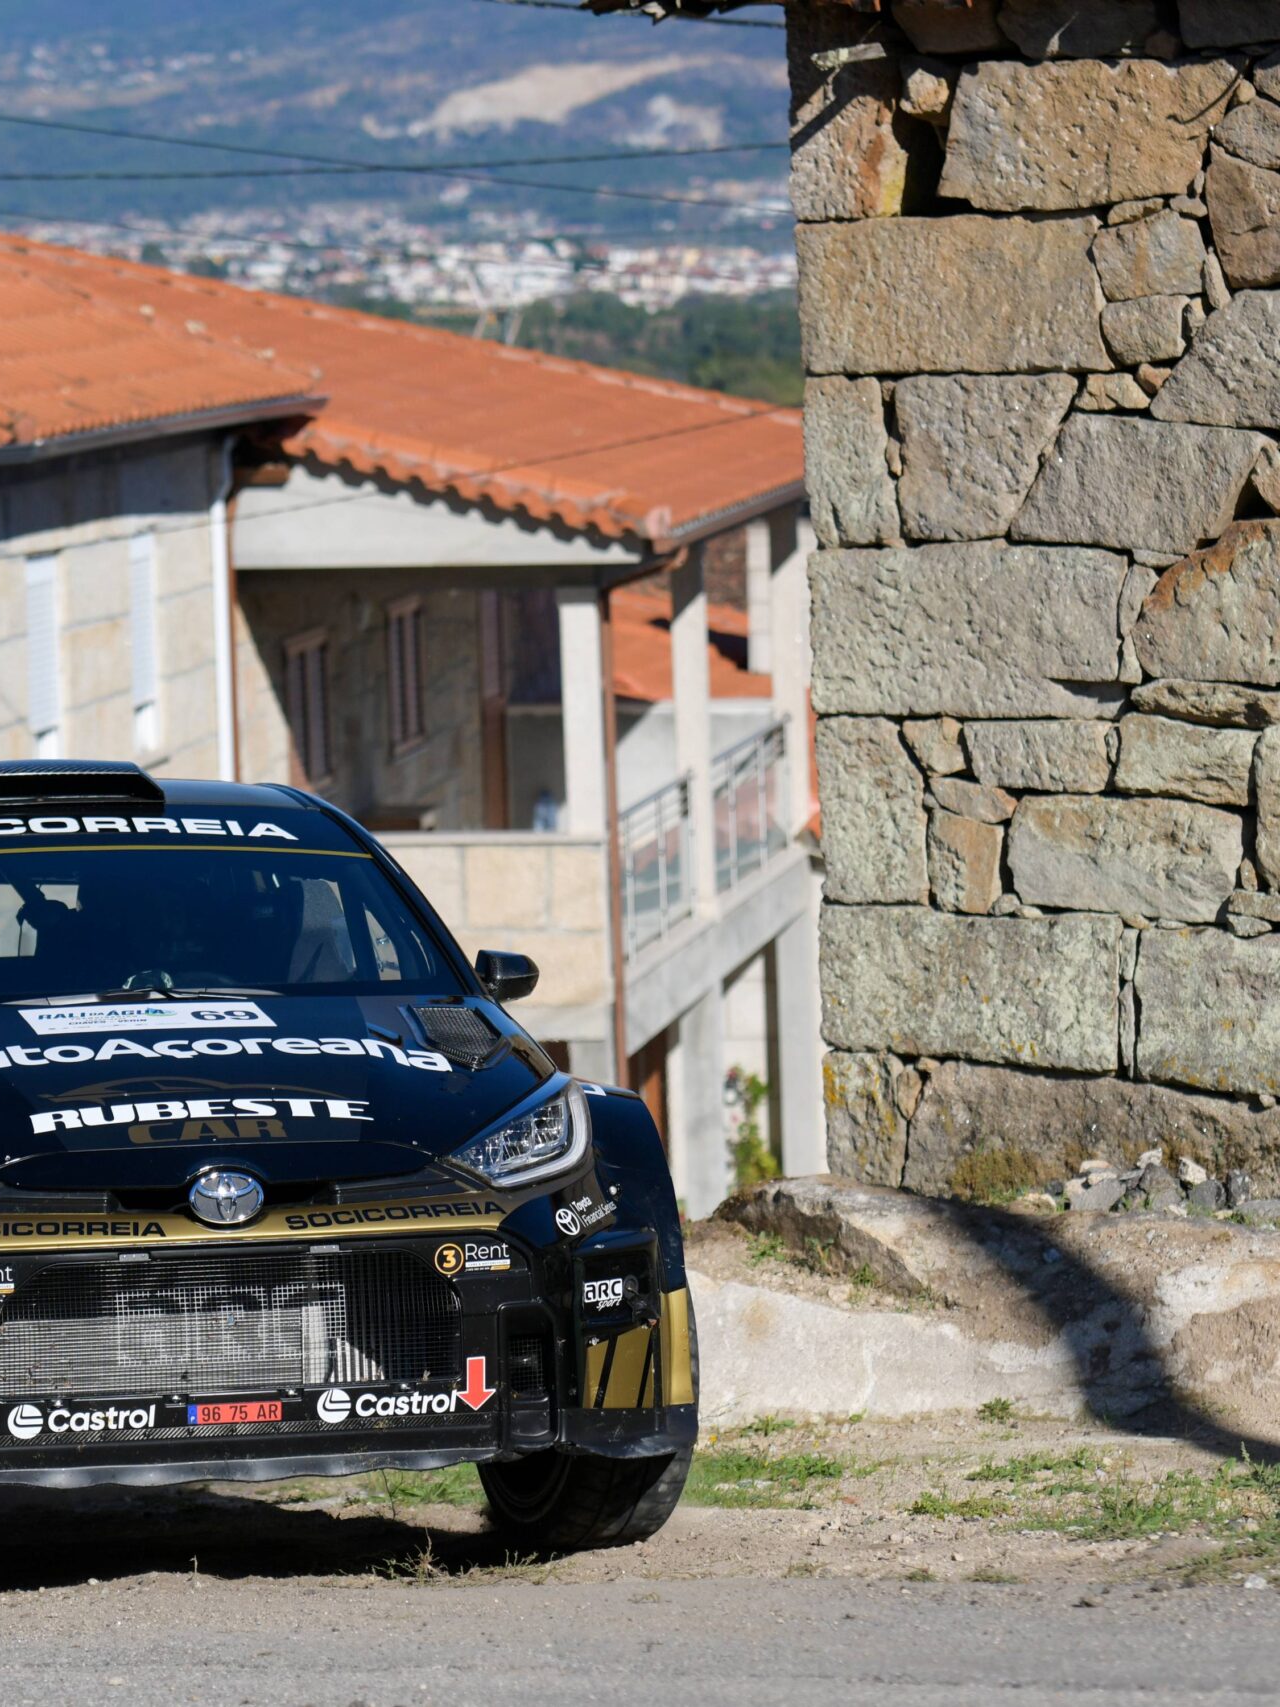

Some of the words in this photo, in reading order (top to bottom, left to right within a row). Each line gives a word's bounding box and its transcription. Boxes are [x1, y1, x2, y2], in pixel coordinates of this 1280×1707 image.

[191, 1010, 259, 1021] 69
[29, 1098, 375, 1134] RUBESTE
[128, 1119, 288, 1144] CAR
[285, 1200, 507, 1230] SOCICORREIA
[442, 1249, 456, 1268] 3
[464, 1242, 510, 1260] Rent
[596, 1298, 622, 1312] sport
[201, 1406, 221, 1422] 96
[229, 1404, 248, 1421] 75
[256, 1403, 279, 1419] AR
[355, 1390, 458, 1418] Castrol
[47, 1404, 156, 1432] Castrol
